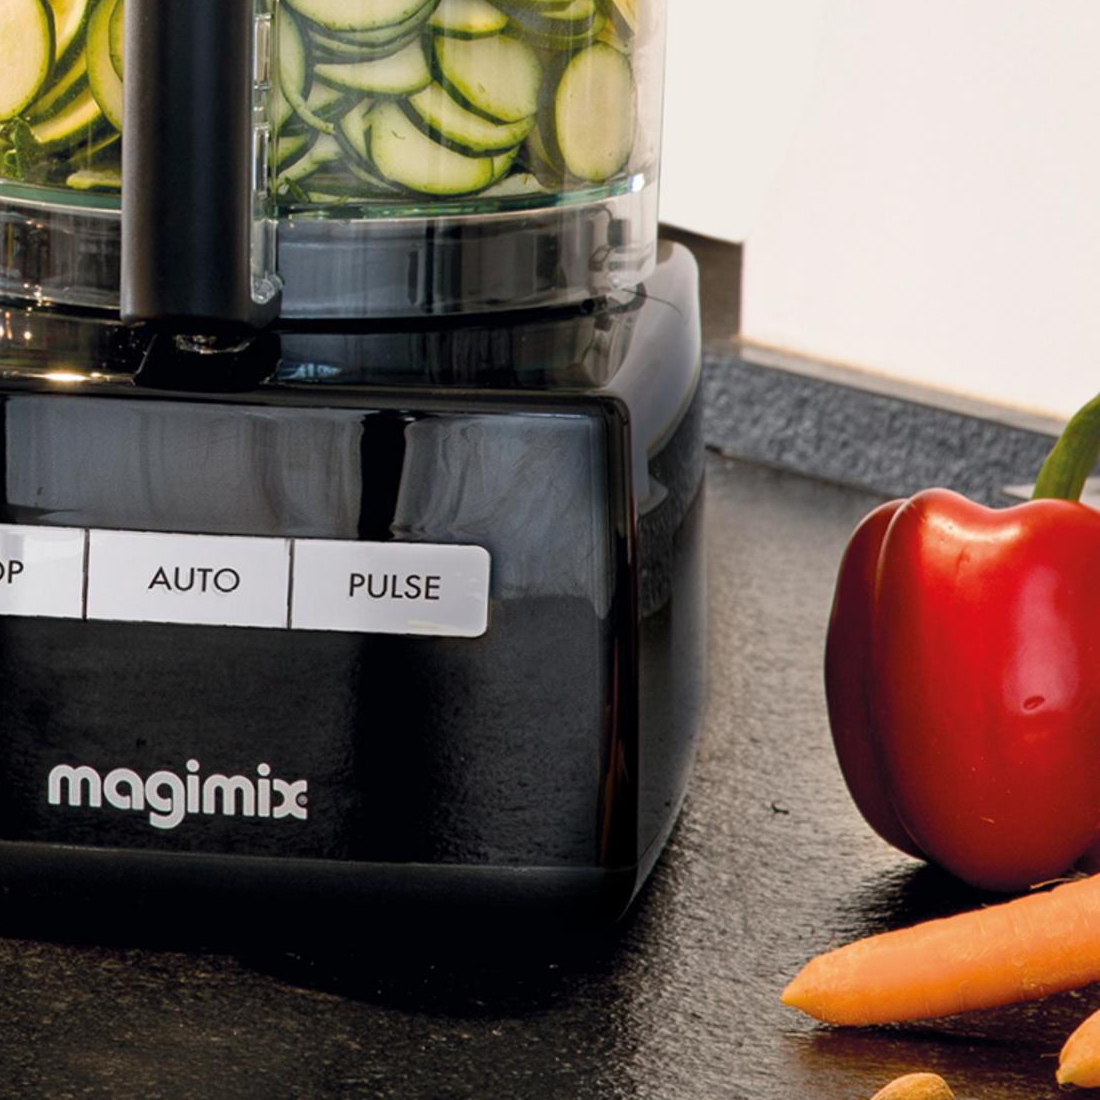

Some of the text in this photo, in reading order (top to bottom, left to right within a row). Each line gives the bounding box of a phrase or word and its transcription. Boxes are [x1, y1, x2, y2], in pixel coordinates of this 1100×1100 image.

[147, 566, 240, 593] AUTO
[348, 572, 441, 601] PULSE
[47, 758, 308, 830] magimix
